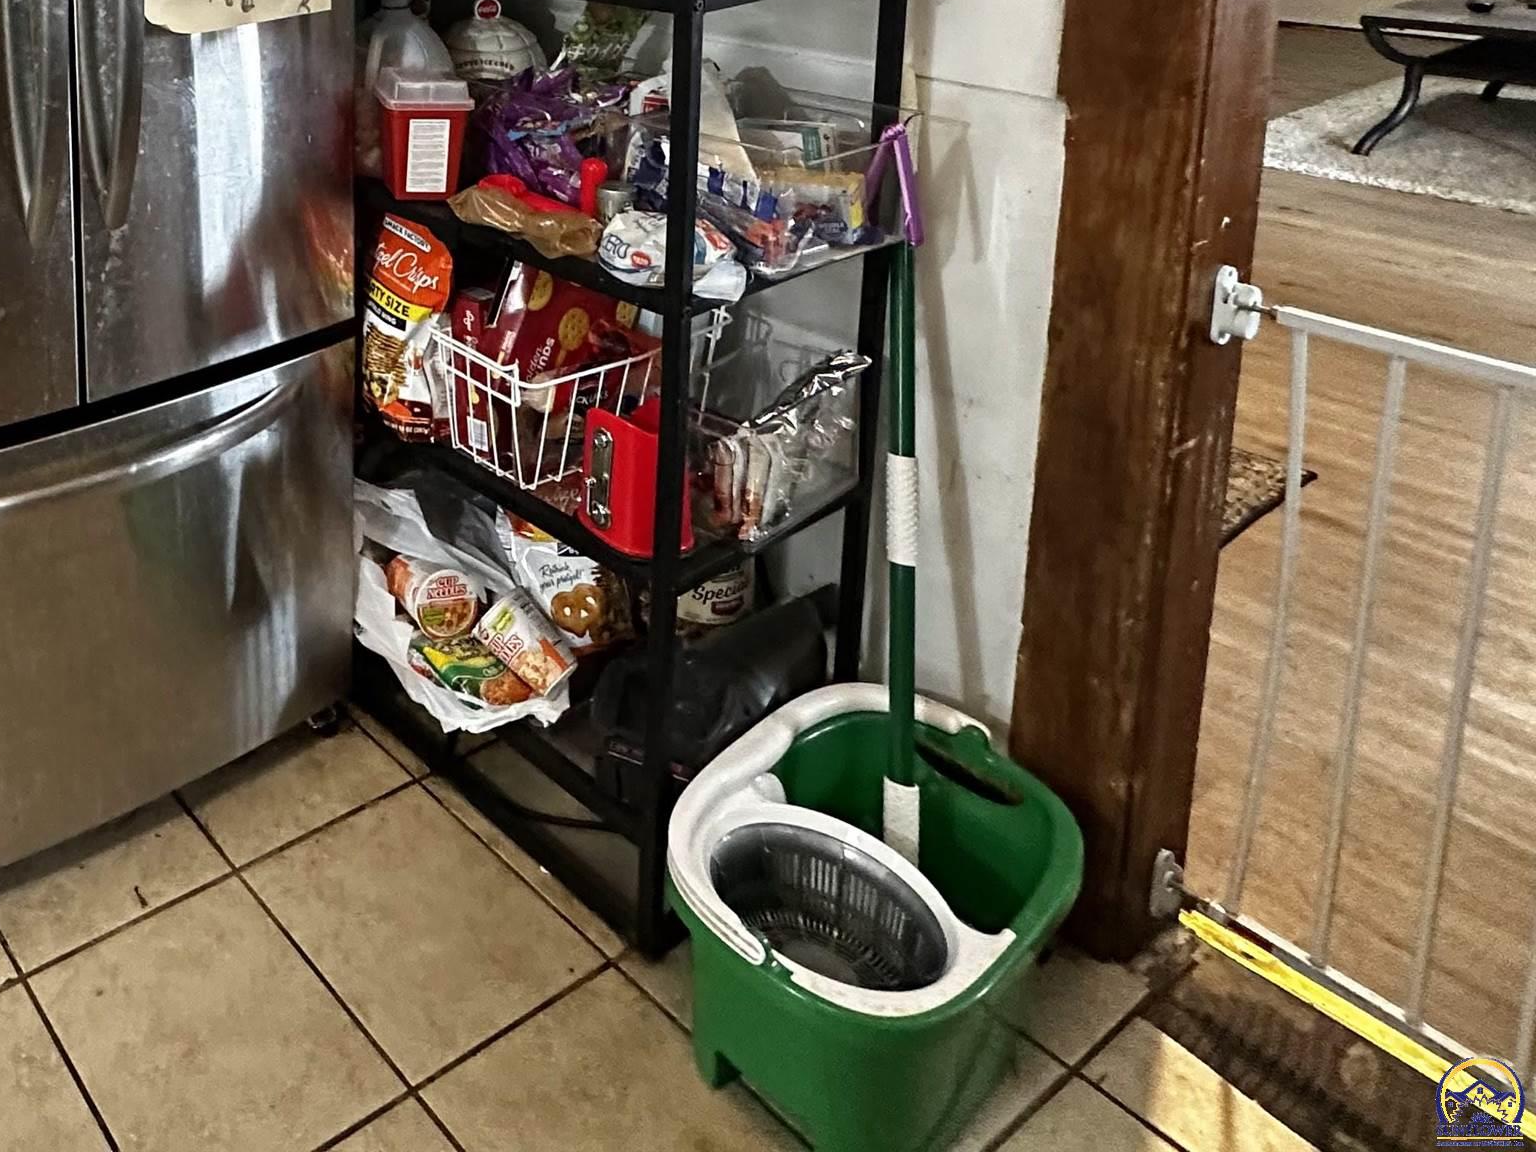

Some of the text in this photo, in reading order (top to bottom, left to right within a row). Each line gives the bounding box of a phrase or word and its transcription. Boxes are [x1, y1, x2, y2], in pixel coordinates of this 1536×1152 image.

[393, 251, 440, 293] Crisps
[385, 291, 410, 318] SIZE
[434, 575, 460, 588] CUP
